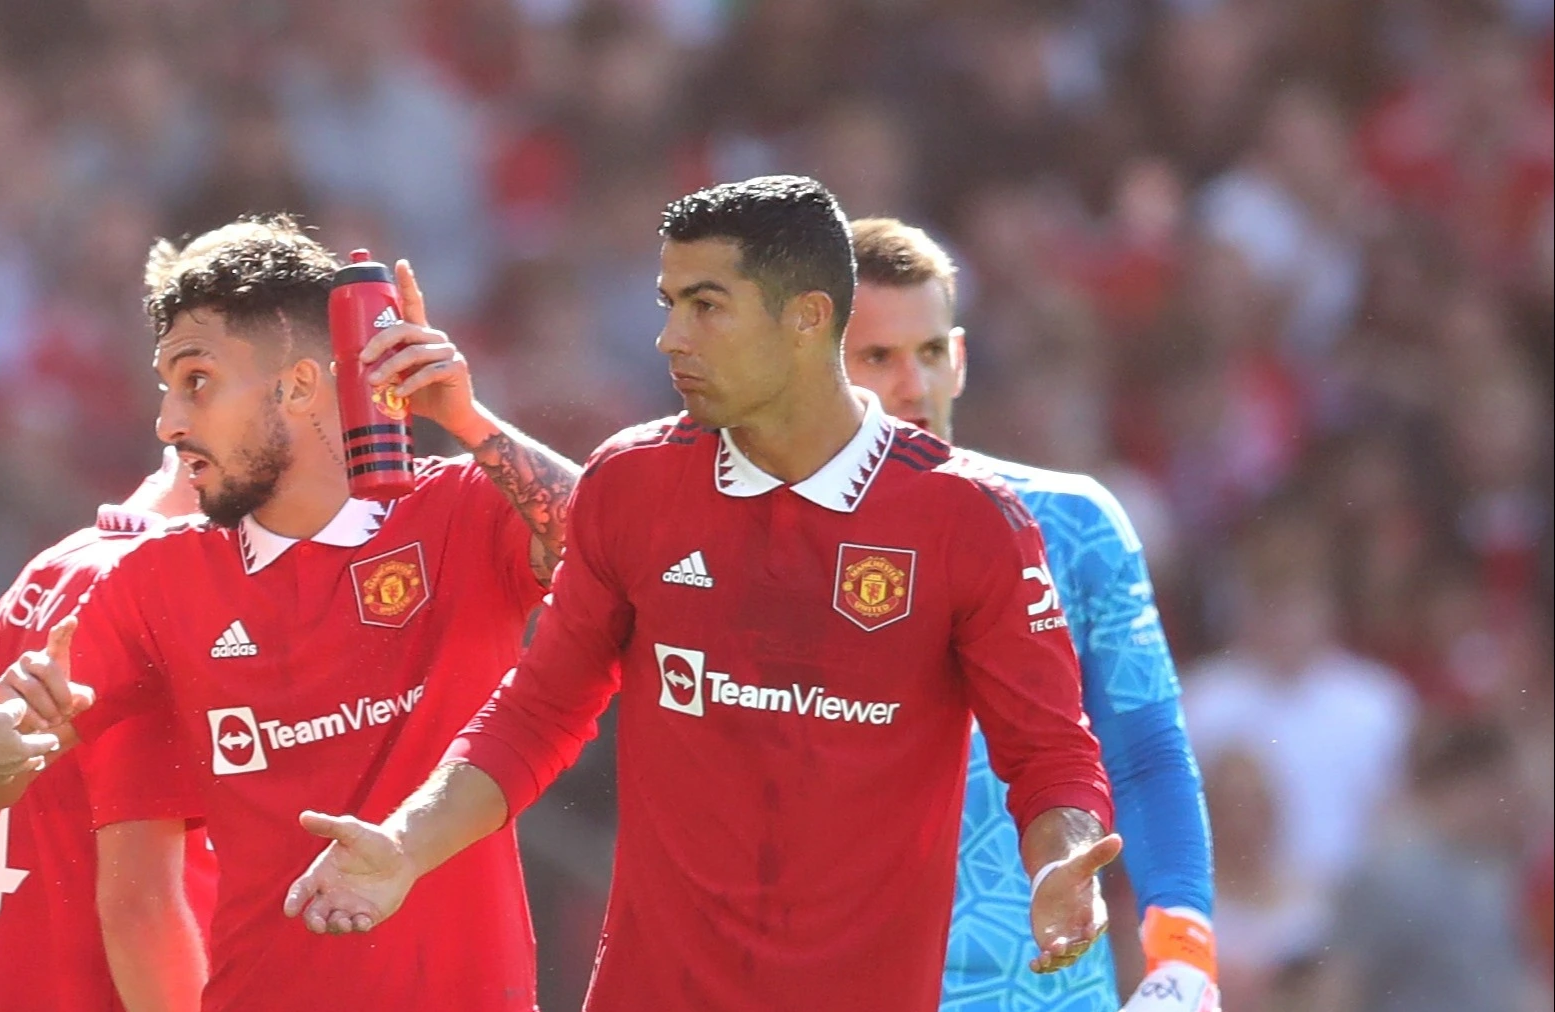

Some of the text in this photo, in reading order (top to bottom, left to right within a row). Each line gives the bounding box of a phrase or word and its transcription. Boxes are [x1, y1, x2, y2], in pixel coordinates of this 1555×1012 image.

[662, 570, 714, 588] adidas
[853, 600, 890, 613] UNITED
[210, 643, 258, 659] adidas
[705, 670, 901, 725] TeamViewer
[259, 676, 428, 750] TeamViewe
